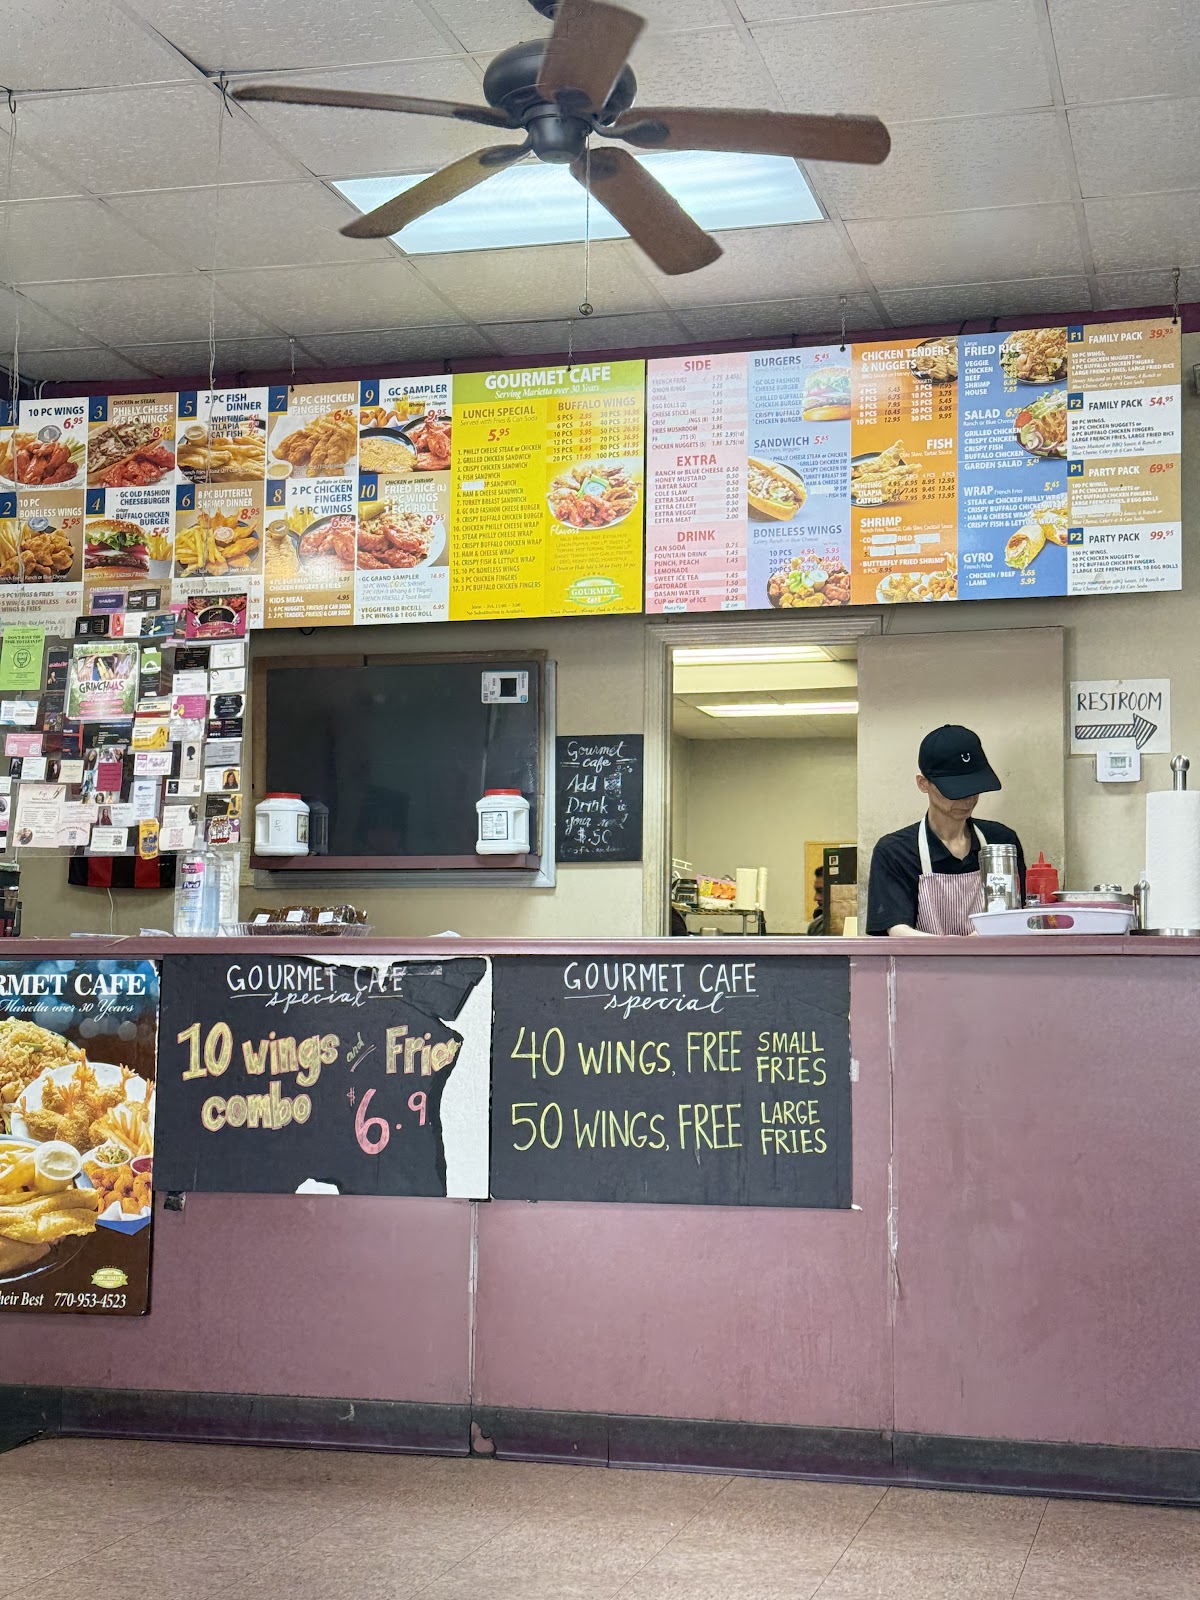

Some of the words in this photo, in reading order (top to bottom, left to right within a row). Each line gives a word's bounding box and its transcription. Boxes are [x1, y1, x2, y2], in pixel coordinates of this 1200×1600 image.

[1071, 332, 1081, 340] F1
[1089, 334, 1118, 344] FAMILY
[1121, 332, 1142, 341] PACK
[1149, 328, 1173, 339] 39.95
[862, 349, 903, 361] CHICKEN
[906, 346, 950, 357] TENDERS
[965, 345, 995, 356] FRIED
[999, 343, 1022, 354] RICE
[684, 360, 711, 372] SIDE
[755, 356, 801, 367] BURGERS
[862, 362, 869, 372] &
[871, 360, 917, 371] NUGGETS
[485, 370, 566, 389] GOURMET
[569, 366, 610, 382] CAFE
[388, 386, 401, 395] GC
[404, 384, 447, 394] SAMPLER
[495, 390, 522, 399] Serving
[523, 387, 553, 397] Marietta
[582, 385, 599, 393] Years
[213, 395, 224, 403] PC
[226, 394, 247, 402] FISH
[275, 395, 286, 409] 7
[292, 396, 298, 405] 4
[300, 396, 312, 405] PC
[314, 394, 354, 404] CHICKEN
[365, 390, 375, 404] 9
[1149, 396, 1173, 407] 54.95
[113, 407, 141, 416] PHILLY
[143, 404, 173, 413] CHEESE
[184, 400, 192, 414] 5
[226, 402, 261, 411] DINNER
[292, 405, 331, 414] FINGERS
[558, 400, 601, 411] BUFFALO
[603, 397, 635, 408] WINGS
[1071, 400, 1081, 408] F2
[1089, 400, 1118, 410] FAMILY
[1121, 399, 1142, 408] PACK
[29, 409, 39, 417] 10
[41, 408, 52, 416] PC
[54, 406, 84, 415] WINGS
[94, 406, 103, 419] 3
[334, 409, 353, 421] 6.45
[427, 409, 447, 423] 9.95
[463, 409, 495, 419] LUNCH
[498, 406, 535, 416] SPECIAL
[965, 409, 1000, 420] SALAD
[63, 417, 83, 429] 6.95
[211, 414, 244, 423] WHITING
[152, 426, 171, 438] 8.45
[211, 423, 239, 431] TILAPIA
[487, 428, 510, 442] 5.95
[754, 438, 809, 449] SANDWICH
[927, 439, 952, 450] FISH
[677, 455, 717, 466] EXTRA
[965, 462, 995, 470] GARDEN
[997, 460, 1022, 468] SALAD
[1071, 464, 1081, 472] P1
[1089, 467, 1115, 476] PARTY
[1117, 466, 1140, 475] PACK
[1149, 463, 1173, 474] 69.95
[292, 486, 298, 495] 2
[300, 486, 312, 495] PC
[314, 484, 353, 494] CHICKEN
[360, 484, 375, 498] 10
[385, 485, 411, 494] FRIED
[414, 484, 435, 492] RICE
[964, 486, 993, 496] WRAP
[120, 497, 170, 506] CHEESEBURGER
[182, 494, 190, 506] 6
[273, 489, 282, 503] 8
[315, 494, 352, 503] FINGERS
[3, 502, 11, 514] 2
[92, 498, 100, 511] 4
[19, 509, 56, 518] BONELESS
[58, 507, 82, 516] WINGS
[241, 508, 259, 520] 8.95
[62, 518, 80, 529] 5.95
[140, 517, 169, 525] BURGER
[331, 516, 351, 528] 6.95
[425, 514, 444, 526] 8.95
[861, 517, 902, 528] SHRIMP
[152, 527, 169, 537] 5.45
[677, 530, 715, 542] DRINK
[753, 527, 805, 538] BONELESS
[807, 526, 842, 535] WINGS
[1071, 532, 1081, 541] P2
[1089, 534, 1115, 543] PARTY
[1118, 532, 1140, 542] PACK
[1150, 530, 1174, 540] 99.95
[863, 559, 898, 567] BUTTERFLY
[920, 557, 945, 565] SHRIMP
[964, 552, 993, 563] GYRO
[1077, 692, 1162, 711] RESTROOM
[567, 741, 624, 761] Gourmet
[583, 756, 611, 773] cafe
[566, 774, 598, 792] Add
[566, 796, 608, 814] Drink
[566, 816, 592, 835] your
[227, 964, 337, 991] GOURMET
[564, 962, 684, 993] GOURMET
[700, 963, 757, 993] CAFE
[74, 974, 146, 996] CAFE
[265, 991, 366, 1014] special
[604, 991, 725, 1019] special
[0, 999, 49, 1013] Marietta
[52, 1003, 75, 1012] over
[79, 1002, 93, 1012] 30
[93, 999, 134, 1022] Years
[757, 1032, 824, 1054] SMALL
[177, 1022, 233, 1081] 10
[242, 1031, 340, 1087] wings
[346, 1032, 364, 1062] and
[510, 1027, 565, 1079] 40
[688, 1031, 742, 1073] FREE
[757, 1056, 827, 1086] FRIES
[201, 1081, 312, 1132] combo
[760, 1100, 820, 1124] LARGE
[512, 1102, 563, 1151] 50
[573, 1109, 670, 1151] WINGS,
[679, 1104, 742, 1149] FREE
[760, 1128, 827, 1155] FRIES
[21, 1291, 44, 1307] Best
[54, 1292, 127, 1308] 770-953-4523
